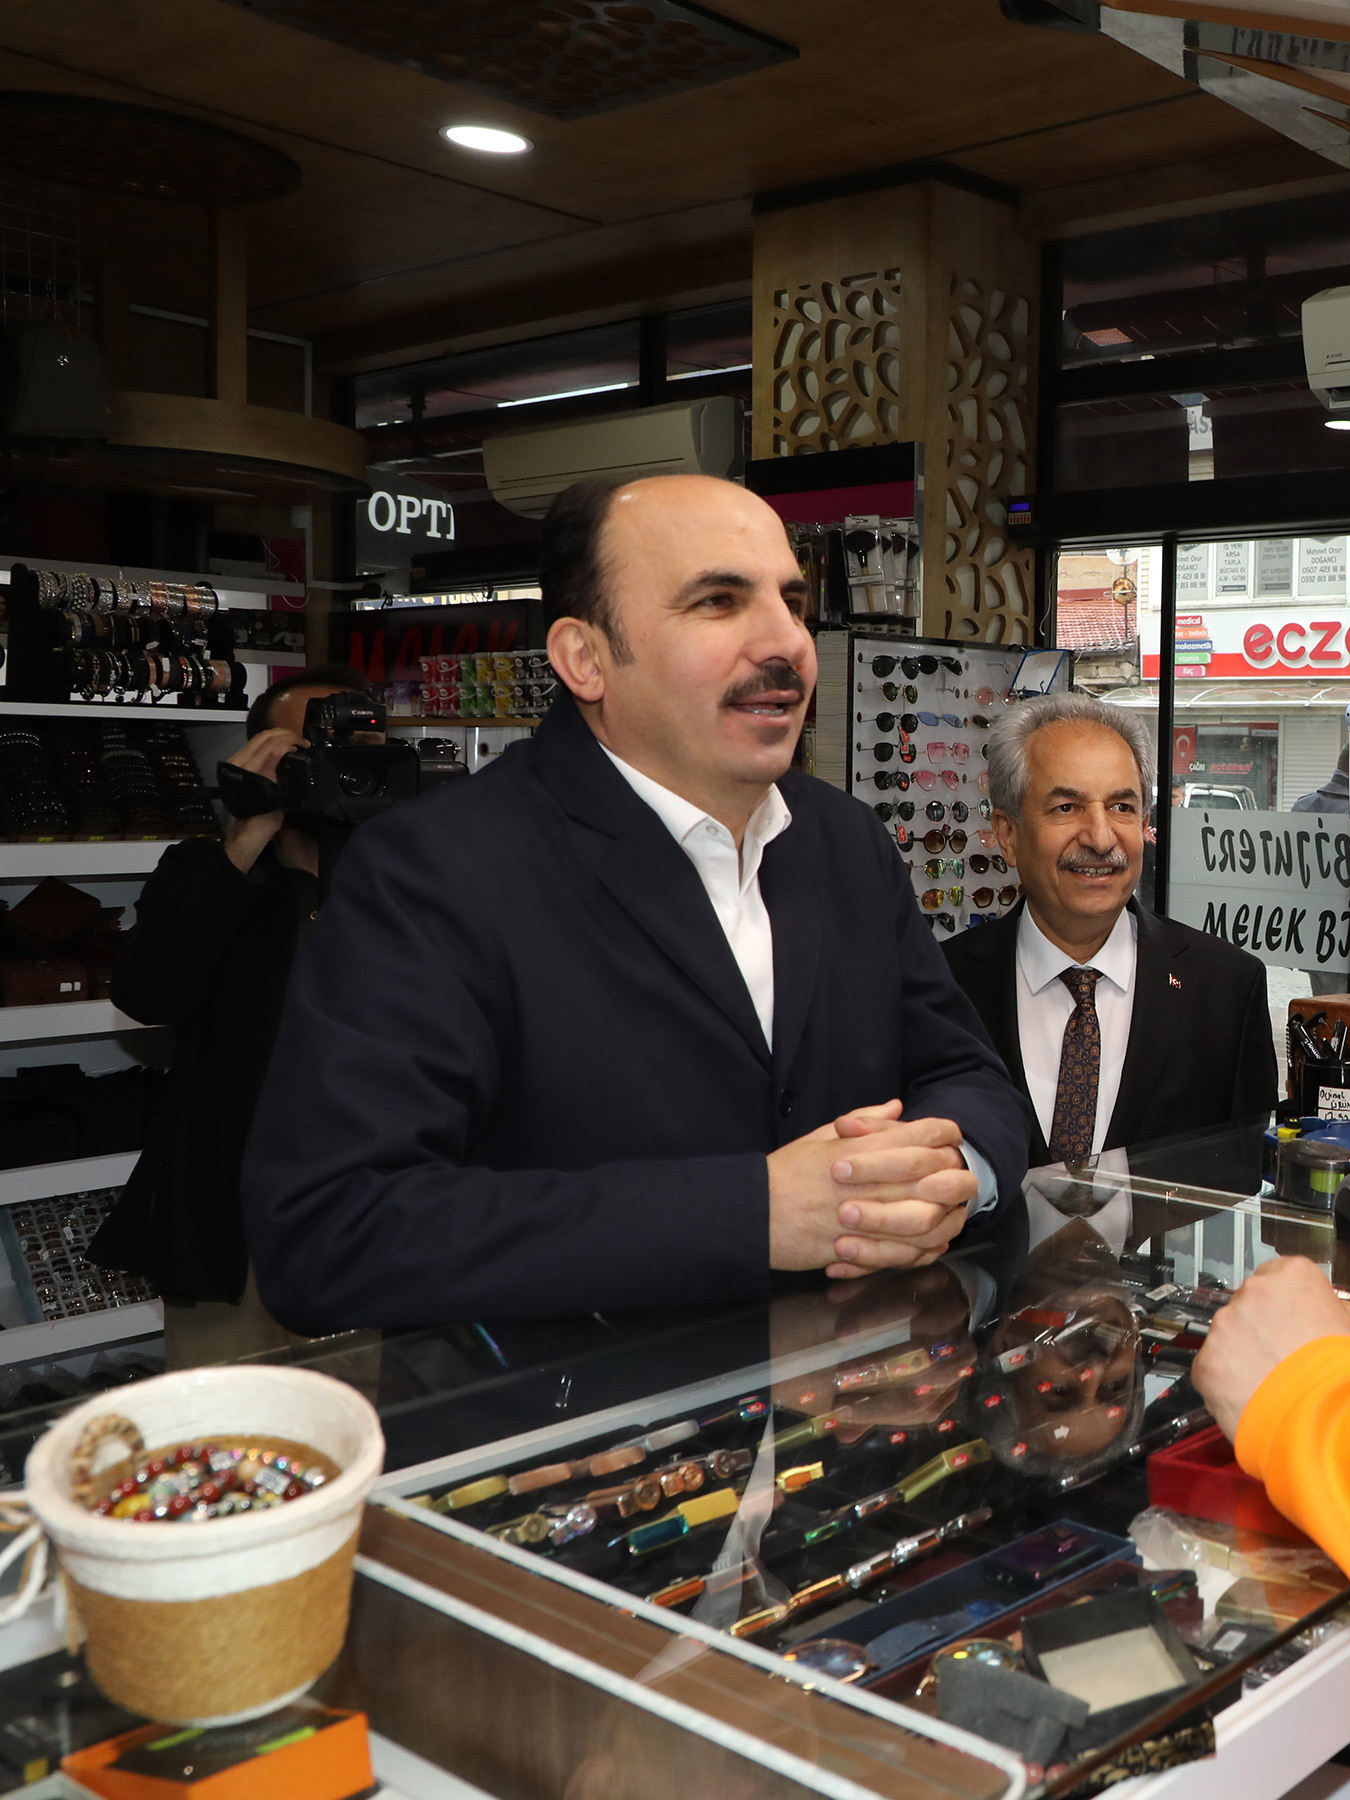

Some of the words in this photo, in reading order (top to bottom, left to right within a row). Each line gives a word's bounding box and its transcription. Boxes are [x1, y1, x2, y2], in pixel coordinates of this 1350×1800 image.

[1311, 555, 1337, 564] DOĞANCI
[1301, 575, 1316, 583] 0332
[1176, 616, 1201, 625] medical
[1188, 629, 1207, 637] bebek
[1182, 666, 1194, 676] ilaç
[1188, 761, 1205, 772] ÇAĞRI
[1202, 901, 1307, 955] MELEK
